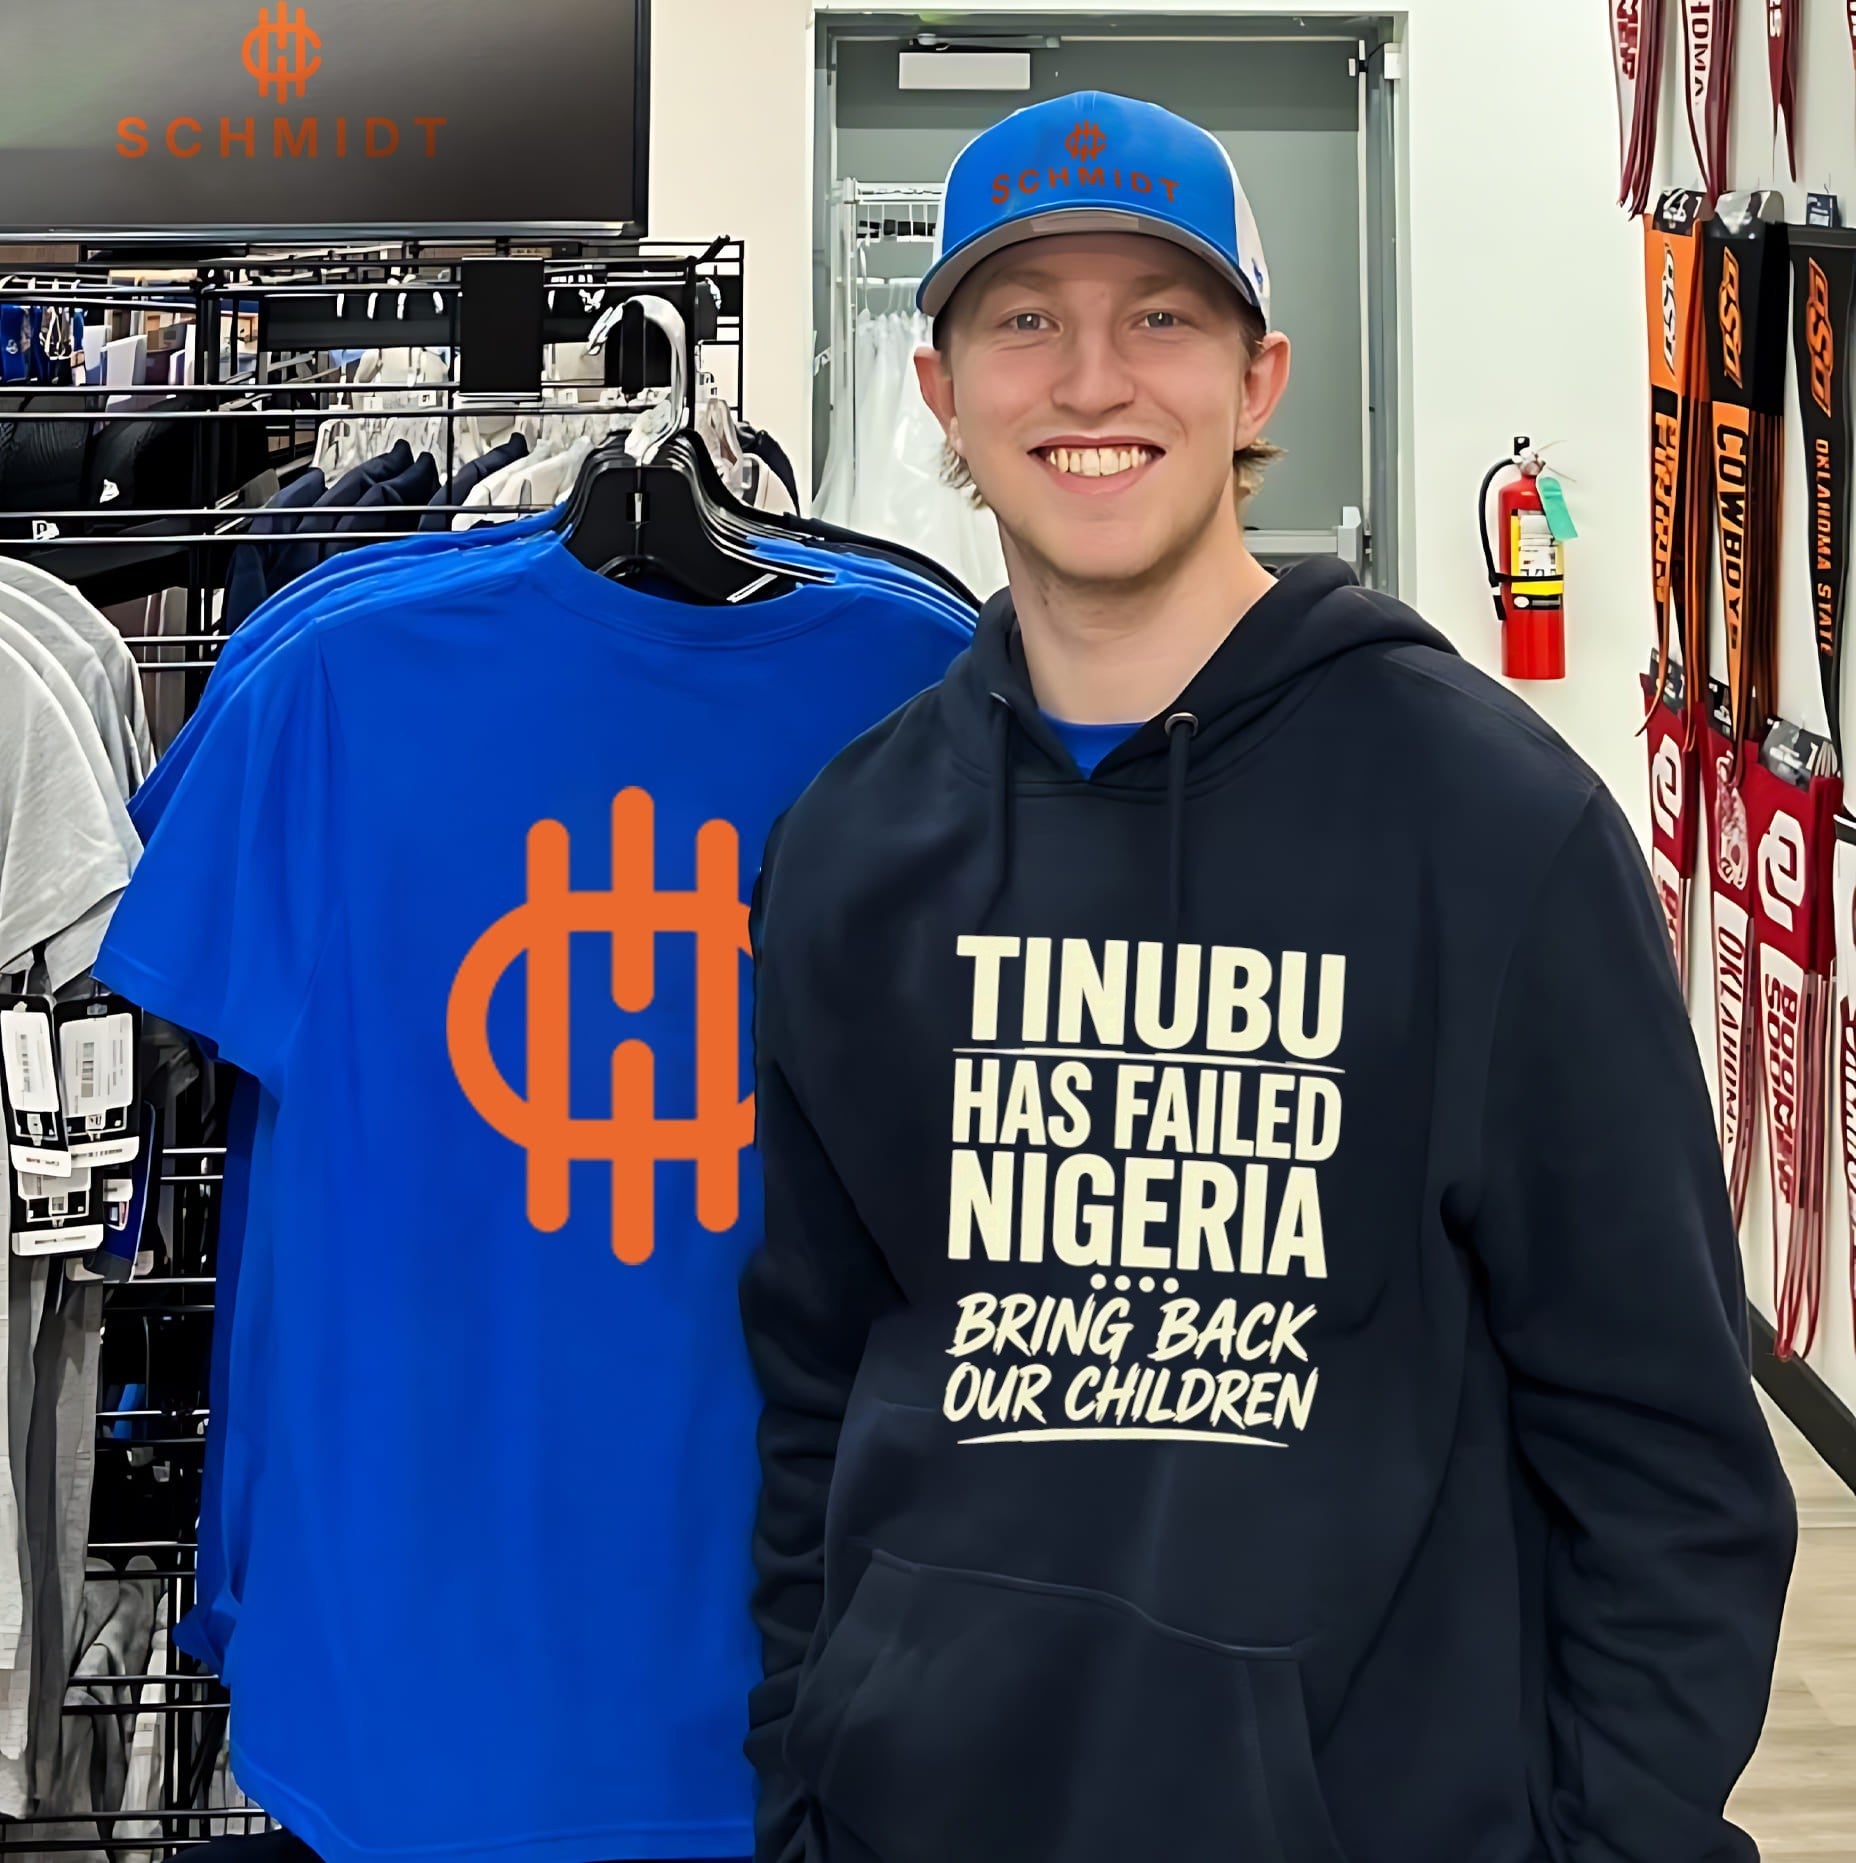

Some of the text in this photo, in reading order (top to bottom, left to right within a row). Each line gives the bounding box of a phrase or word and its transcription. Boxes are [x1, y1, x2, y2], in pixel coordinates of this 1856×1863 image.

[115, 116, 447, 159] SCHMIDT
[991, 167, 1179, 205] SCHMIDT
[1815, 438, 1832, 571] OKLAHOMA
[956, 935, 1346, 1059] TINUBU
[1717, 926, 1745, 1144] OKLAHOMA
[952, 1058, 1342, 1161] HAS FAILED
[947, 1149, 1328, 1278] NIGERIA
[945, 1292, 1317, 1363] BRING BACK
[942, 1362, 1318, 1431] OUR CHILDREN
